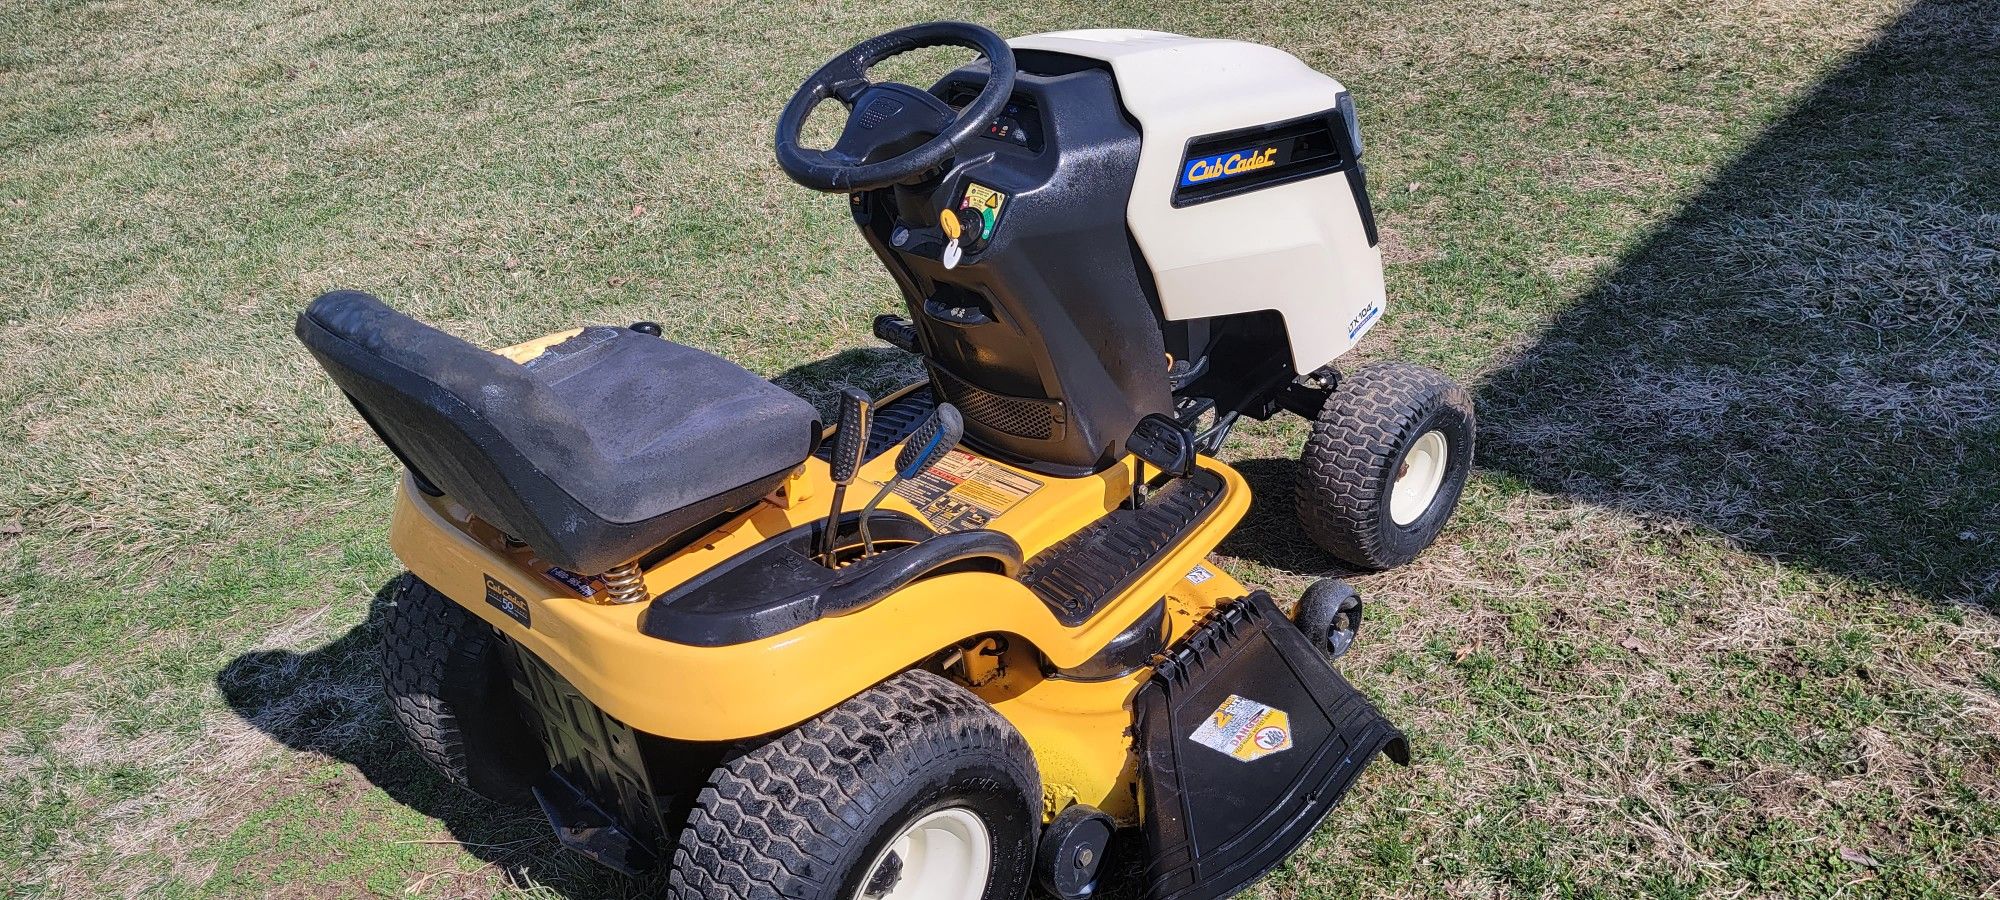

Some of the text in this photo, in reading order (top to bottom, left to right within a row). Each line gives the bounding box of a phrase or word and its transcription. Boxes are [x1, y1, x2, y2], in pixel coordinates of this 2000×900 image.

[1188, 147, 1278, 182] Cub Cadet
[1348, 316, 1360, 333] LTX
[486, 580, 502, 595] Cub
